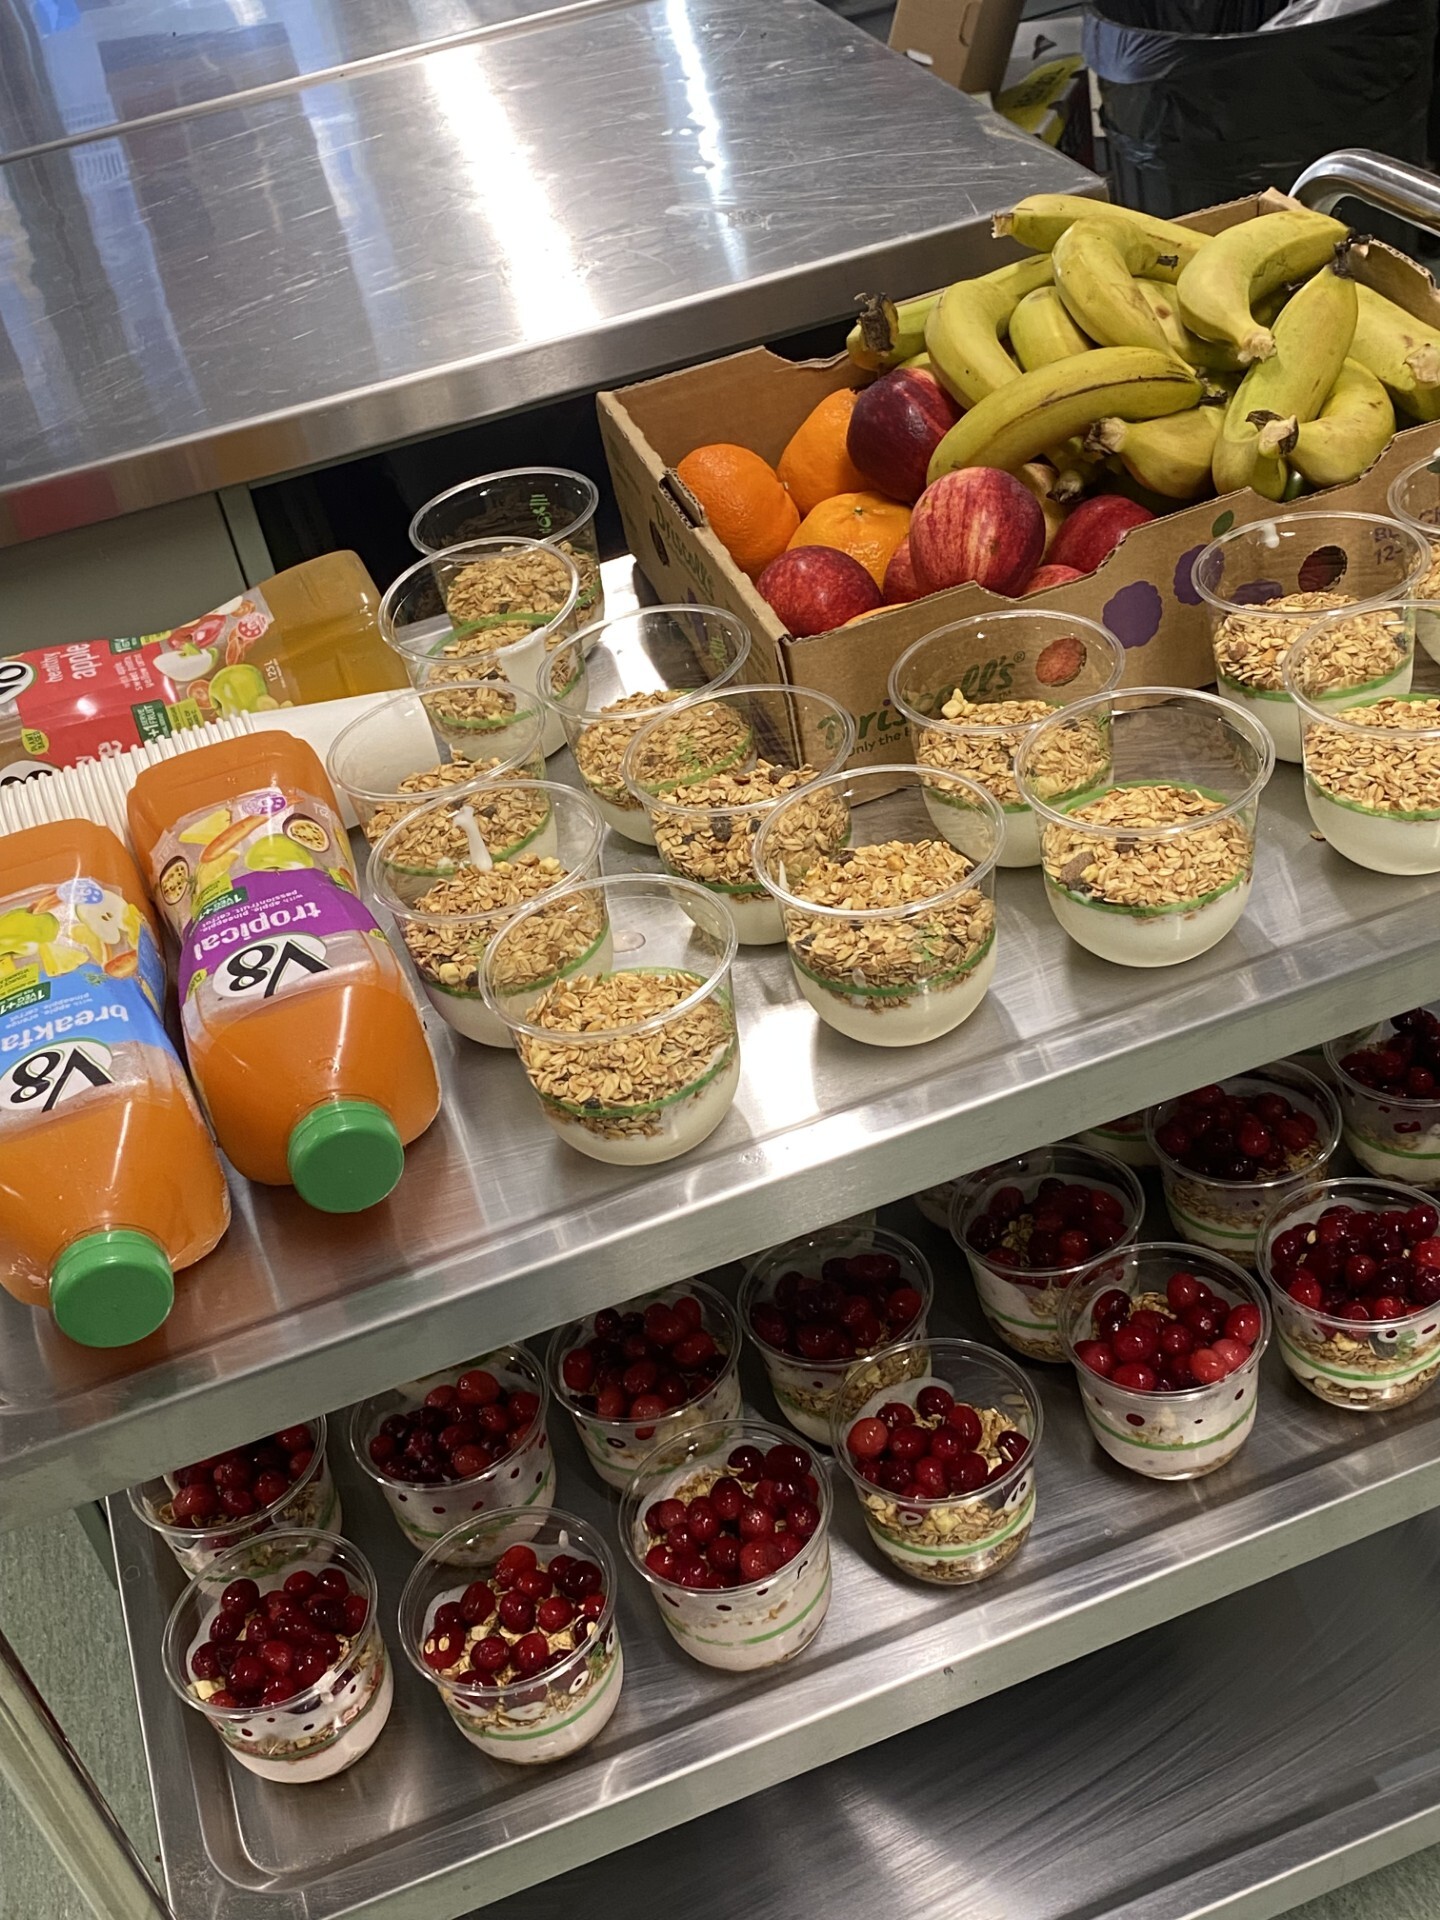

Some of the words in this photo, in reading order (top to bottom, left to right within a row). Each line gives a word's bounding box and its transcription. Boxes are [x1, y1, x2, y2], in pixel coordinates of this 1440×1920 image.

[40, 652, 63, 683] healthy
[60, 643, 102, 679] apple
[144, 705, 158, 725] FRUIT
[25, 733, 38, 752] PLANT
[879, 733, 901, 746] the
[282, 894, 303, 903] with
[193, 902, 321, 961] tropical
[227, 941, 331, 998] V8
[10, 1048, 114, 1113] V8
